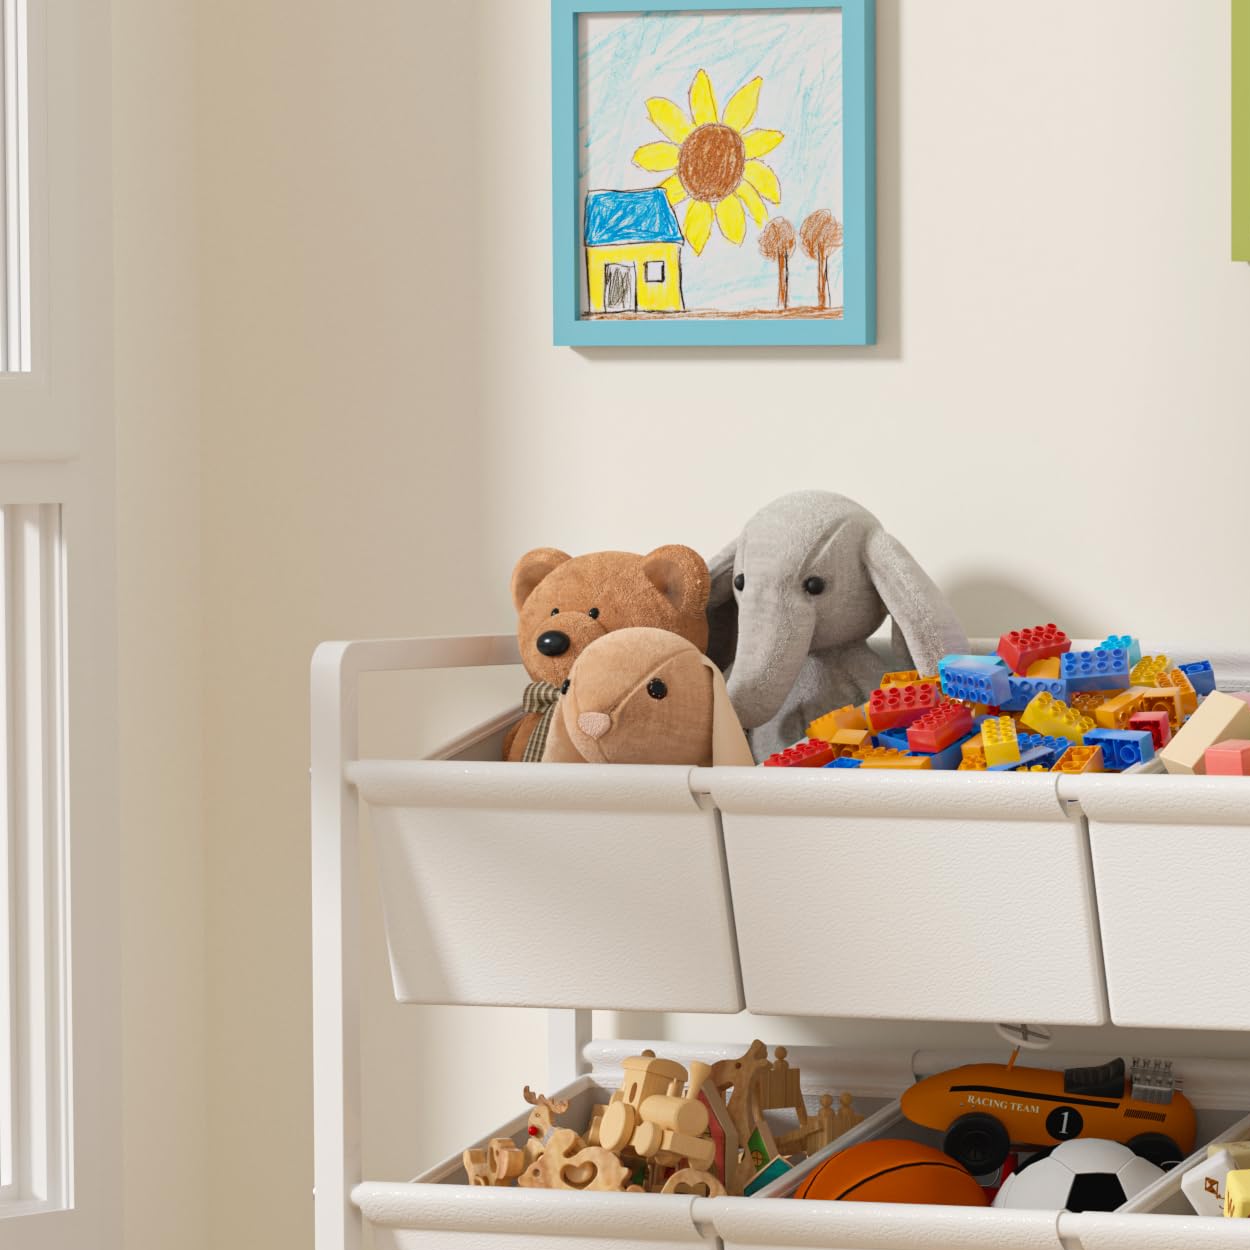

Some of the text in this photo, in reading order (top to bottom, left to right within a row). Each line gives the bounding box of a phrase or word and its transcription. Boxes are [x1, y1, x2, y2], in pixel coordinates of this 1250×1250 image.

[967, 1094, 1041, 1114] RACING TEAM
[1059, 1111, 1069, 1135] 1
